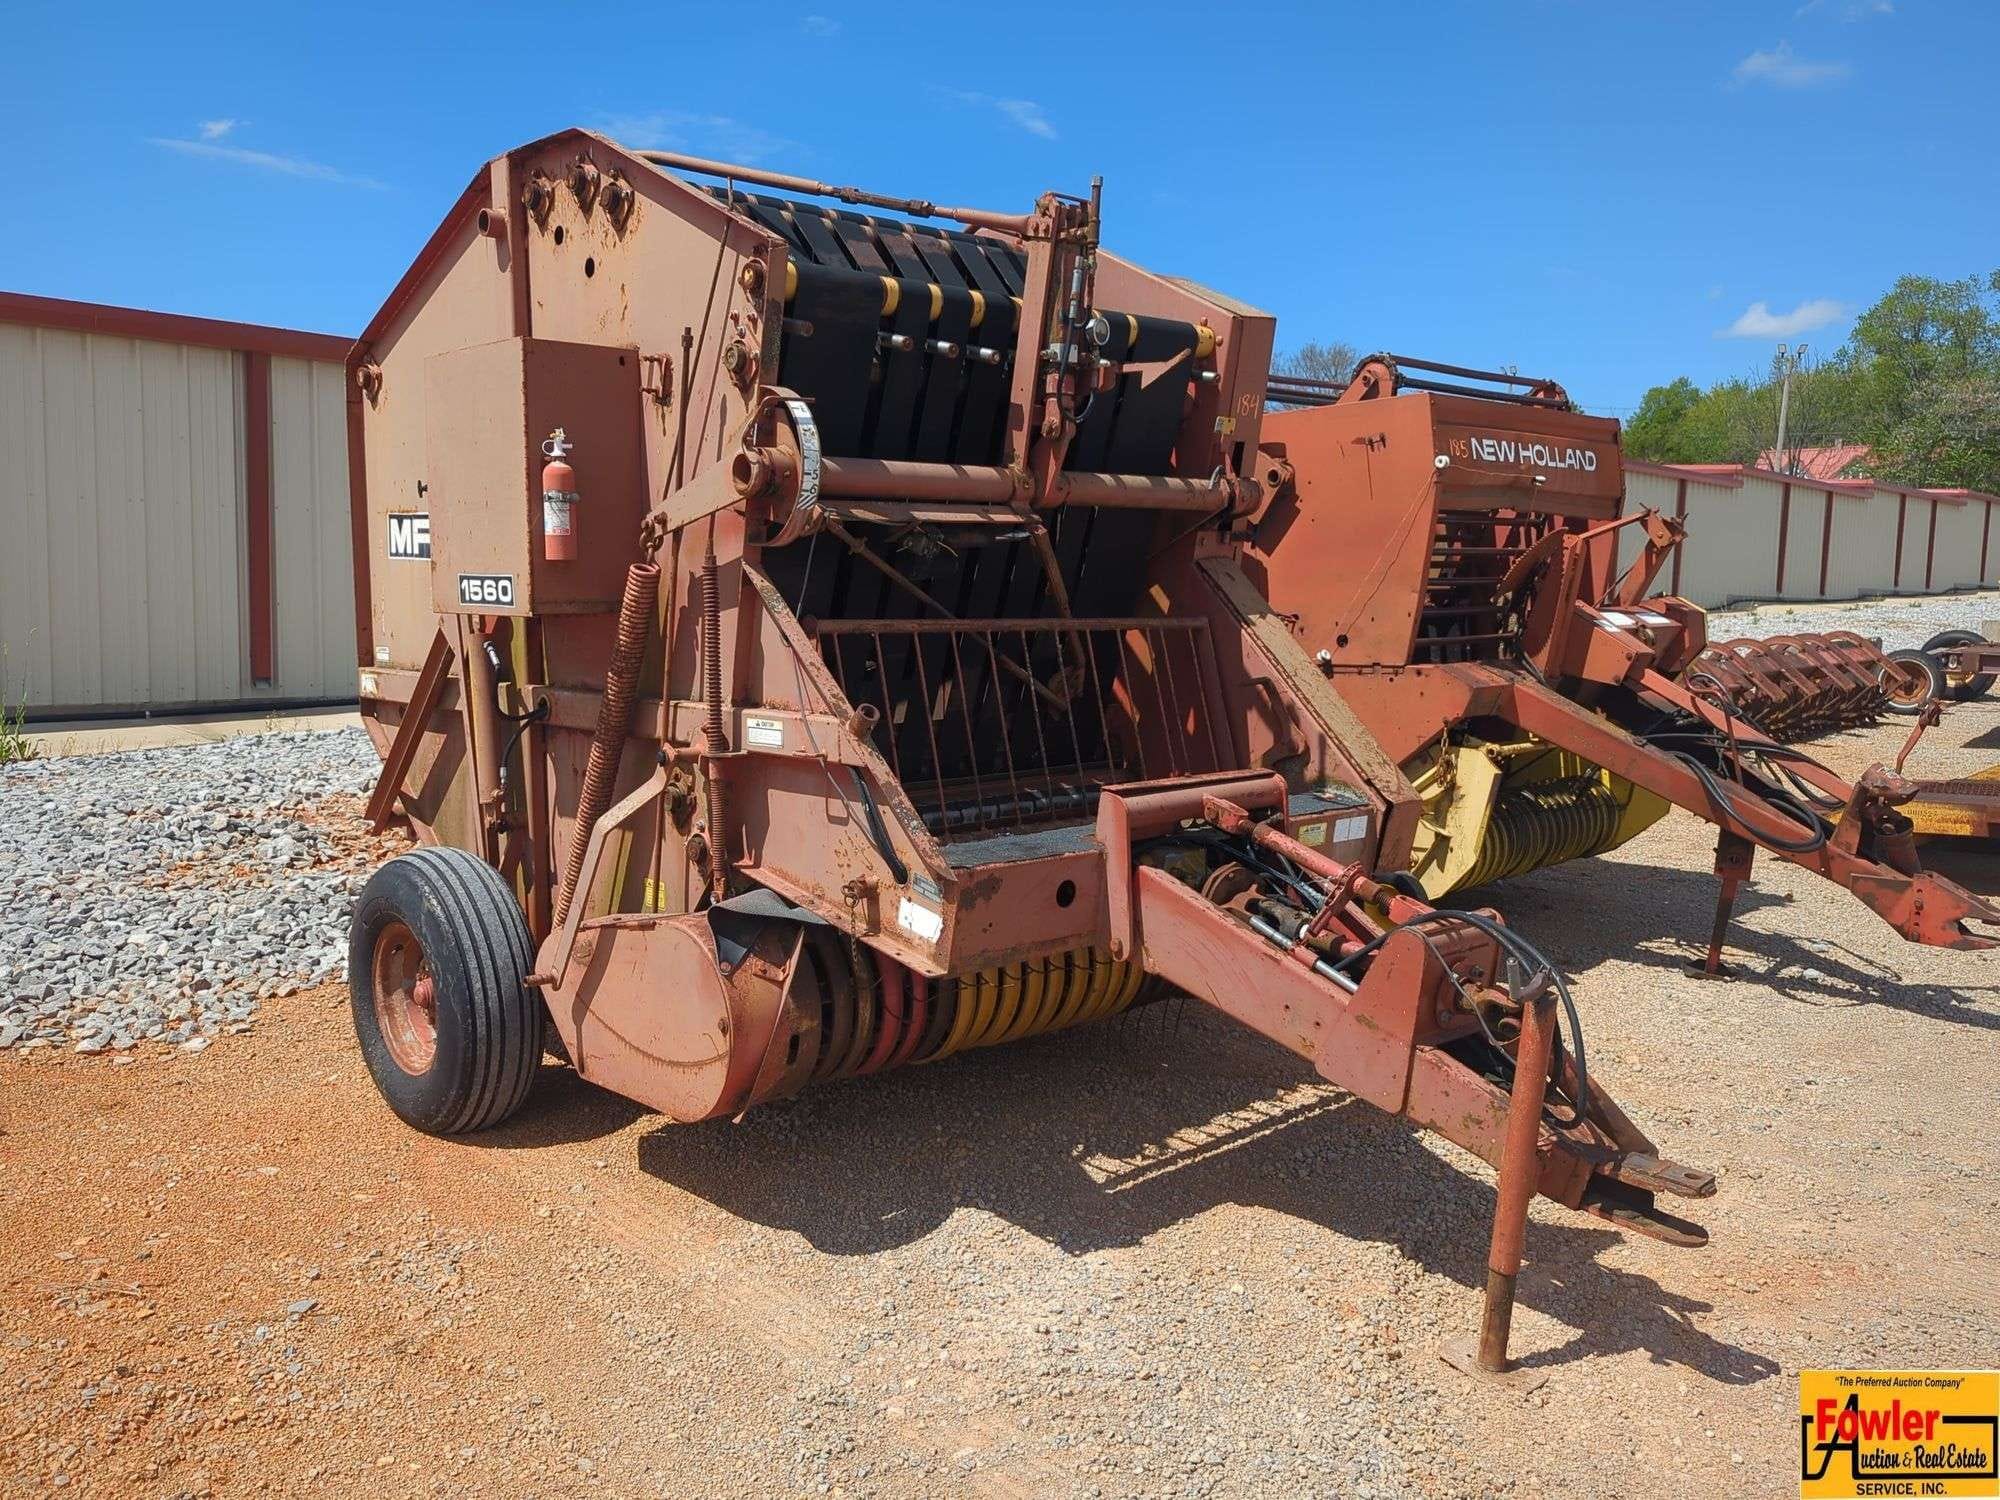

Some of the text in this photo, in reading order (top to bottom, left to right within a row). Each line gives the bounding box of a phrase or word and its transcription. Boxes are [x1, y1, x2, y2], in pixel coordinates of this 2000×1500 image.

[1236, 394, 1260, 419] 184
[1449, 438, 1469, 458] 185
[1470, 437, 1597, 471] NEW HOLLAND
[390, 518, 430, 555] MF
[461, 579, 512, 602] 1560
